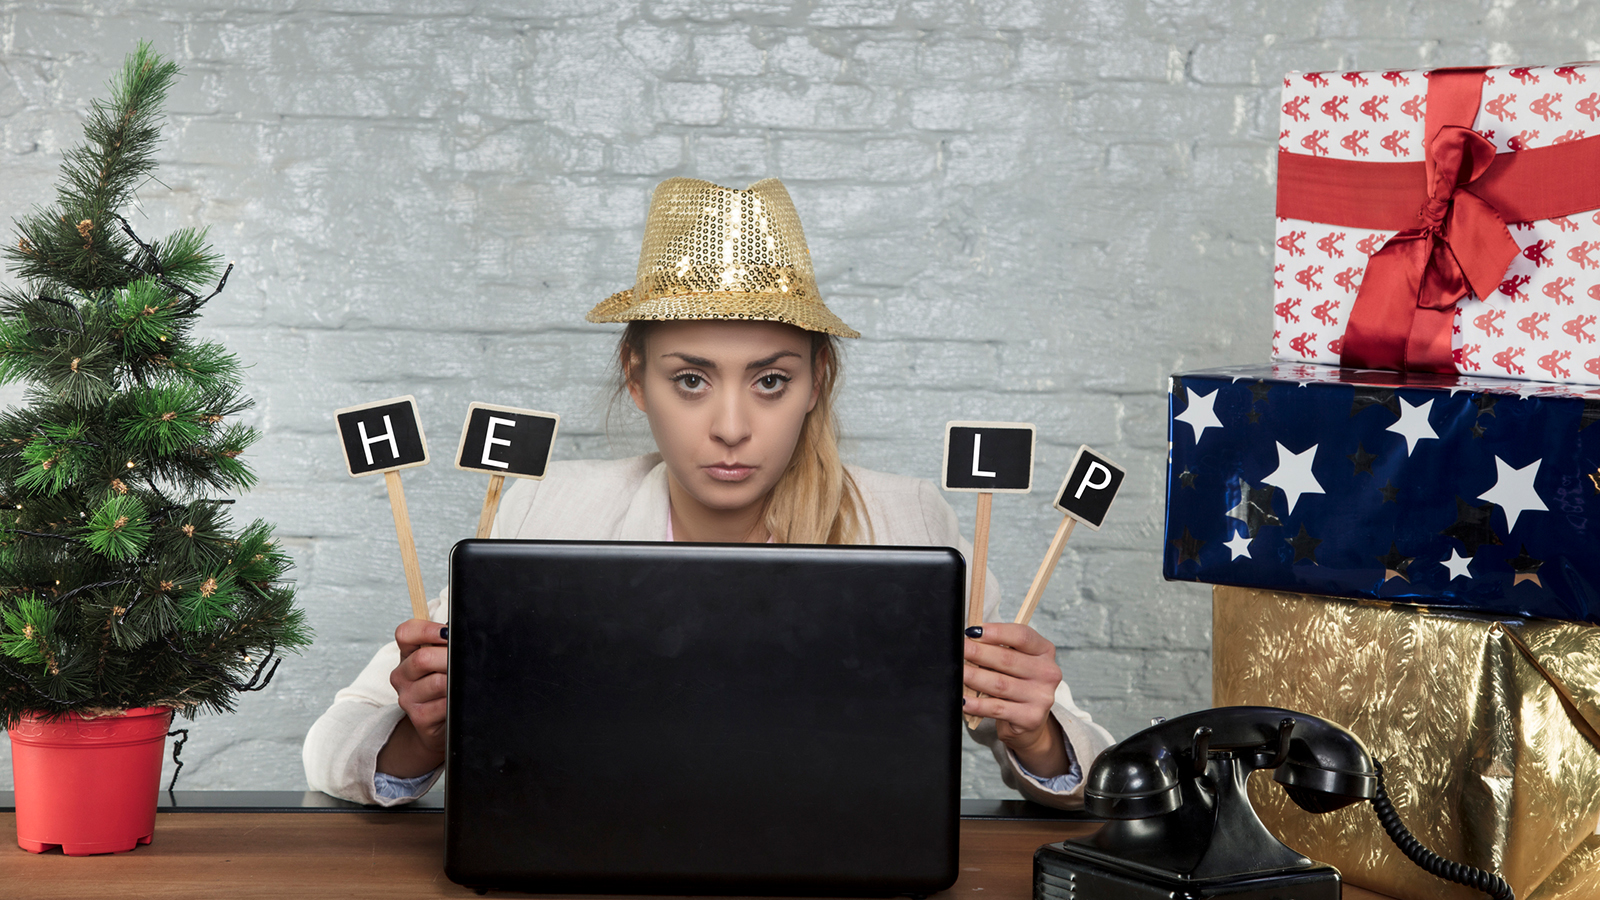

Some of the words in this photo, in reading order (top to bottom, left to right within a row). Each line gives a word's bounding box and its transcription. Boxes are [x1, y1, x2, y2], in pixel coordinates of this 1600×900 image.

[357, 414, 400, 465] H
[481, 416, 516, 469] E
[971, 433, 997, 478] L
[1074, 460, 1112, 500] P
